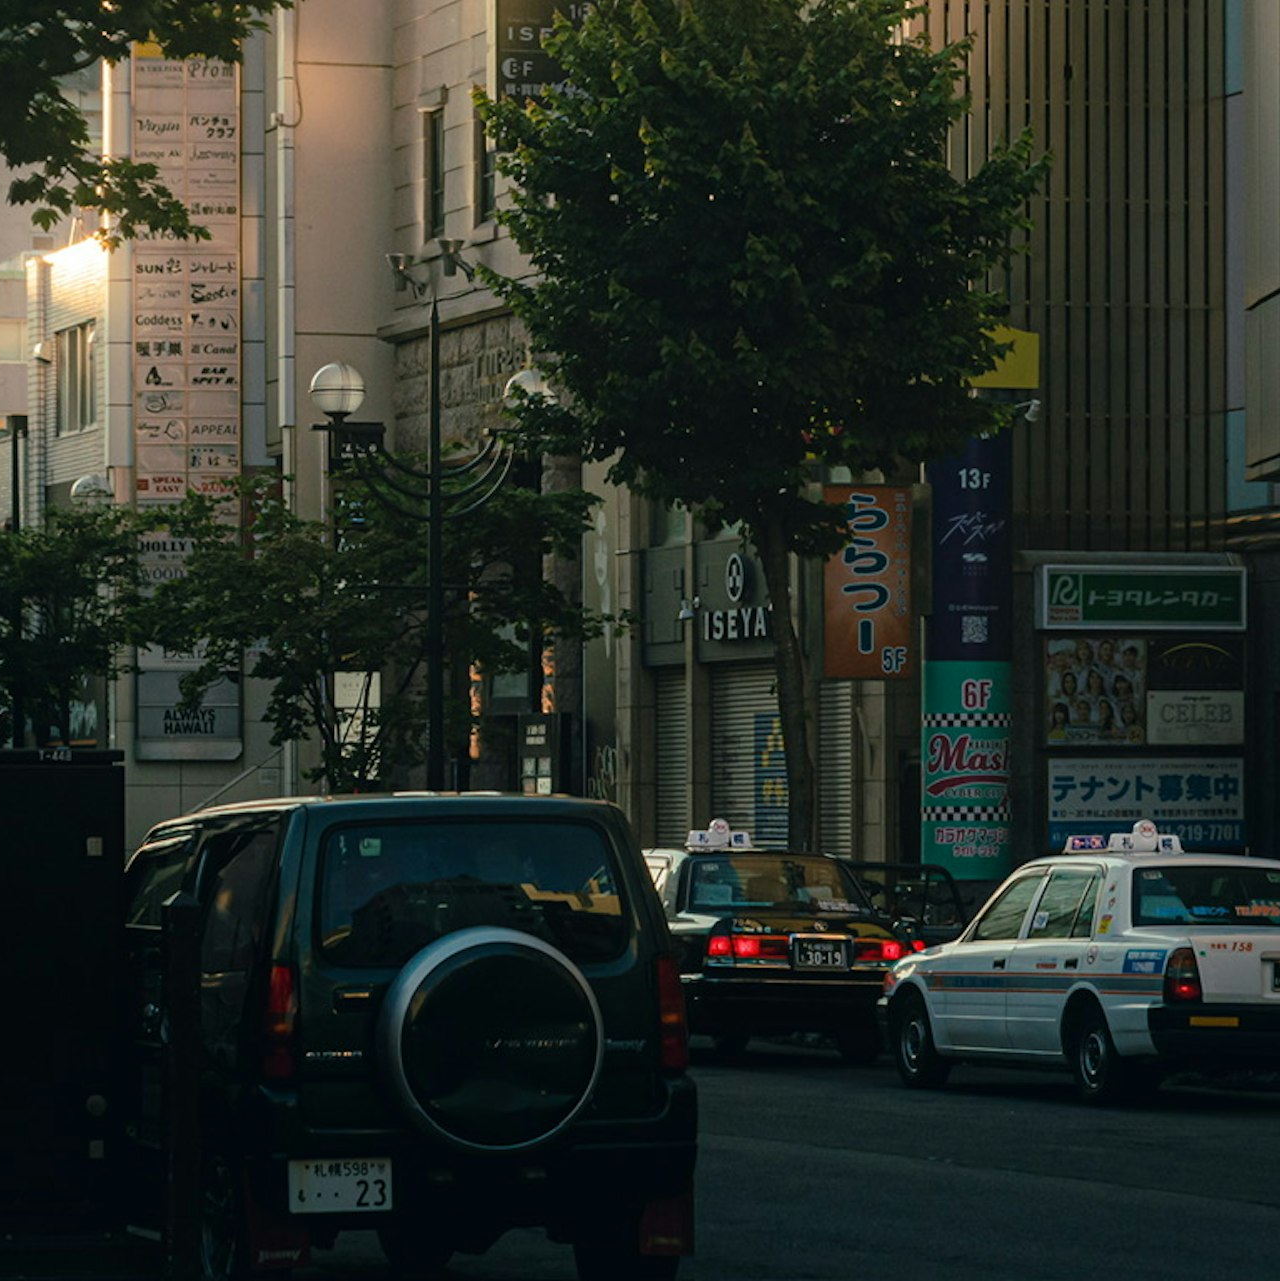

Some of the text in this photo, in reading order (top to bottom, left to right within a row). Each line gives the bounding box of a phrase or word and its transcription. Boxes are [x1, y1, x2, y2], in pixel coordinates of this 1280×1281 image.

[136, 119, 180, 135] Virgin
[135, 315, 183, 326] Goddess
[191, 424, 238, 436] APPEAL
[958, 467, 992, 490] 13F
[156, 485, 181, 493] EASY
[1088, 590, 1235, 607] トヨタレンタカー
[703, 606, 767, 642] ISEYA
[882, 647, 907, 673] 5F
[963, 681, 992, 709] 6F
[163, 708, 216, 721] ALWAYS
[1160, 703, 1233, 725] CELEB
[163, 721, 216, 735] HAWAII
[945, 787, 980, 799] CYBER
[1051, 774, 1240, 803] テナント募集中
[1231, 942, 1254, 952] 158
[805, 951, 842, 966] 30-19
[313, 1162, 369, 1177] 札幌598
